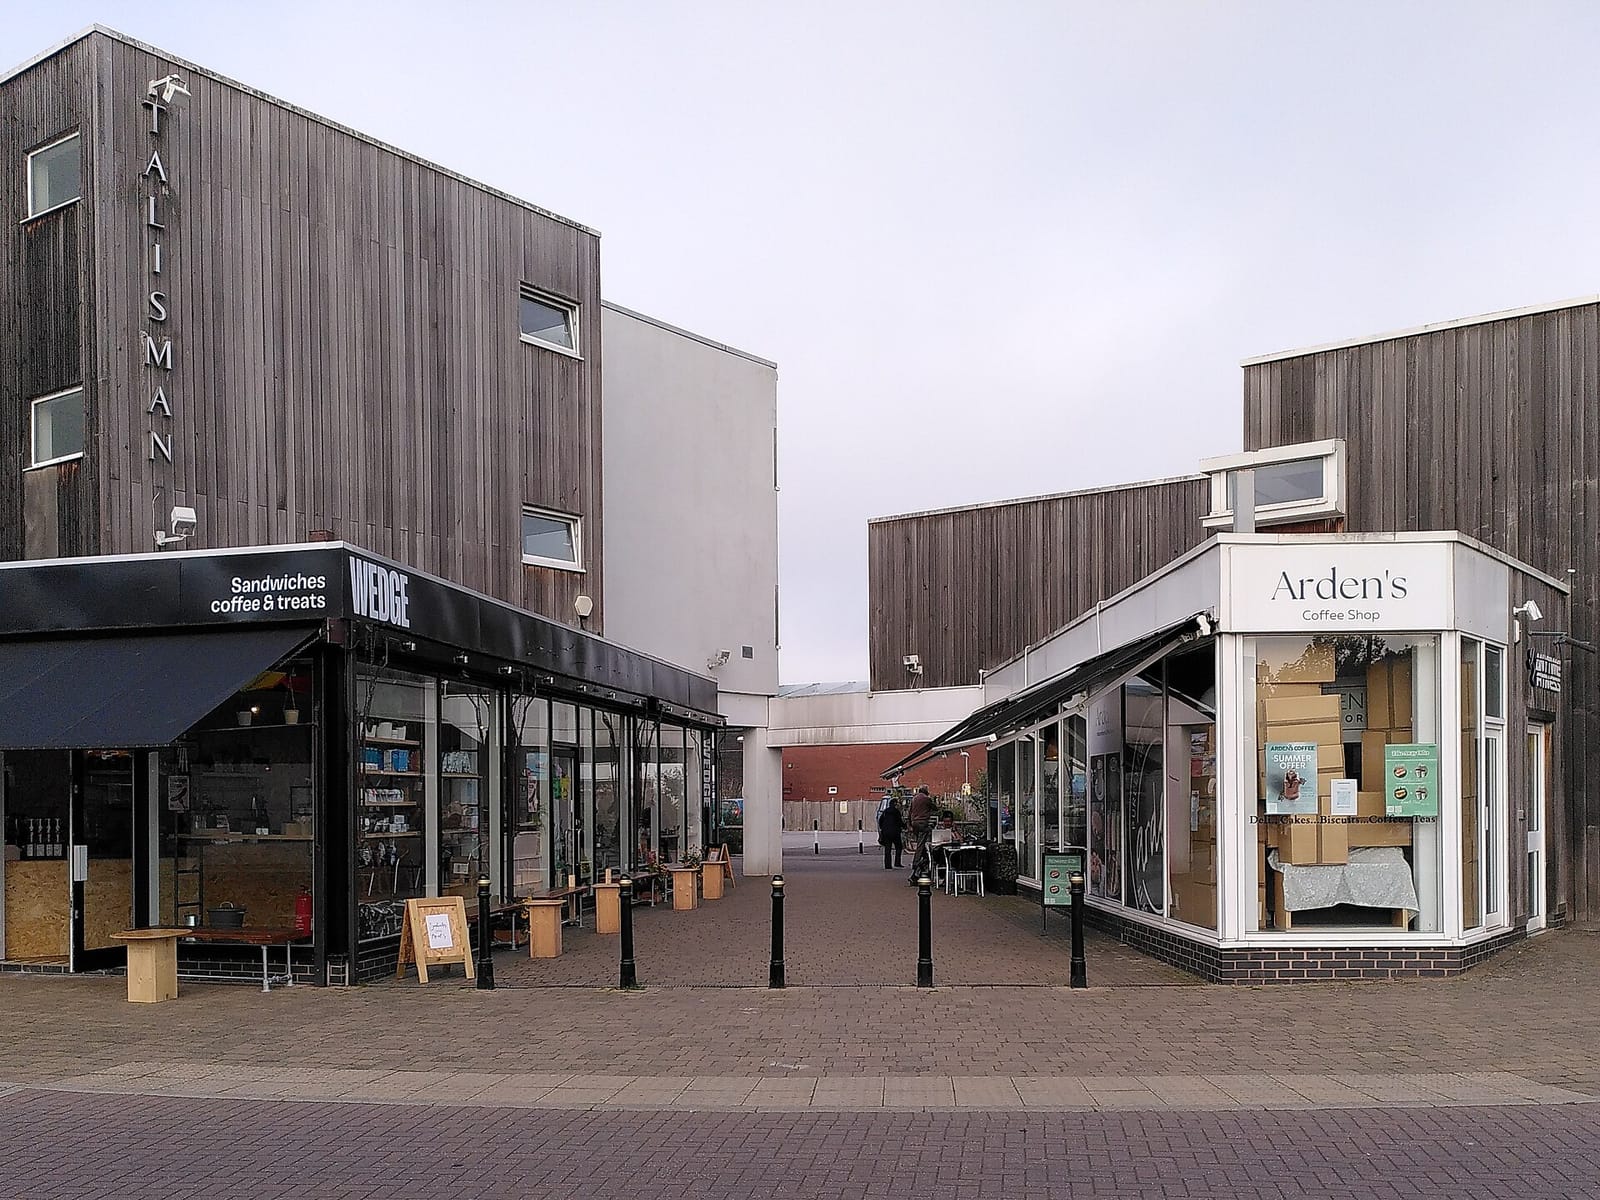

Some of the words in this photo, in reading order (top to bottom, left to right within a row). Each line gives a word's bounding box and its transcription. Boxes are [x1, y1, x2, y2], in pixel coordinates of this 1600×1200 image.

[142, 99, 173, 463] TALISMAN
[231, 573, 326, 593] Sandwiches
[349, 556, 411, 629] WEDGE
[1270, 566, 1408, 601] Arden's
[210, 595, 261, 613] coffee
[263, 595, 275, 611] &
[277, 593, 326, 610] treats
[1302, 609, 1345, 621] Coffee
[1347, 609, 1381, 622] Shop
[1273, 754, 1312, 763] SUMMER
[1279, 762, 1306, 770] OFFER
[703, 738, 711, 808] WEDGE
